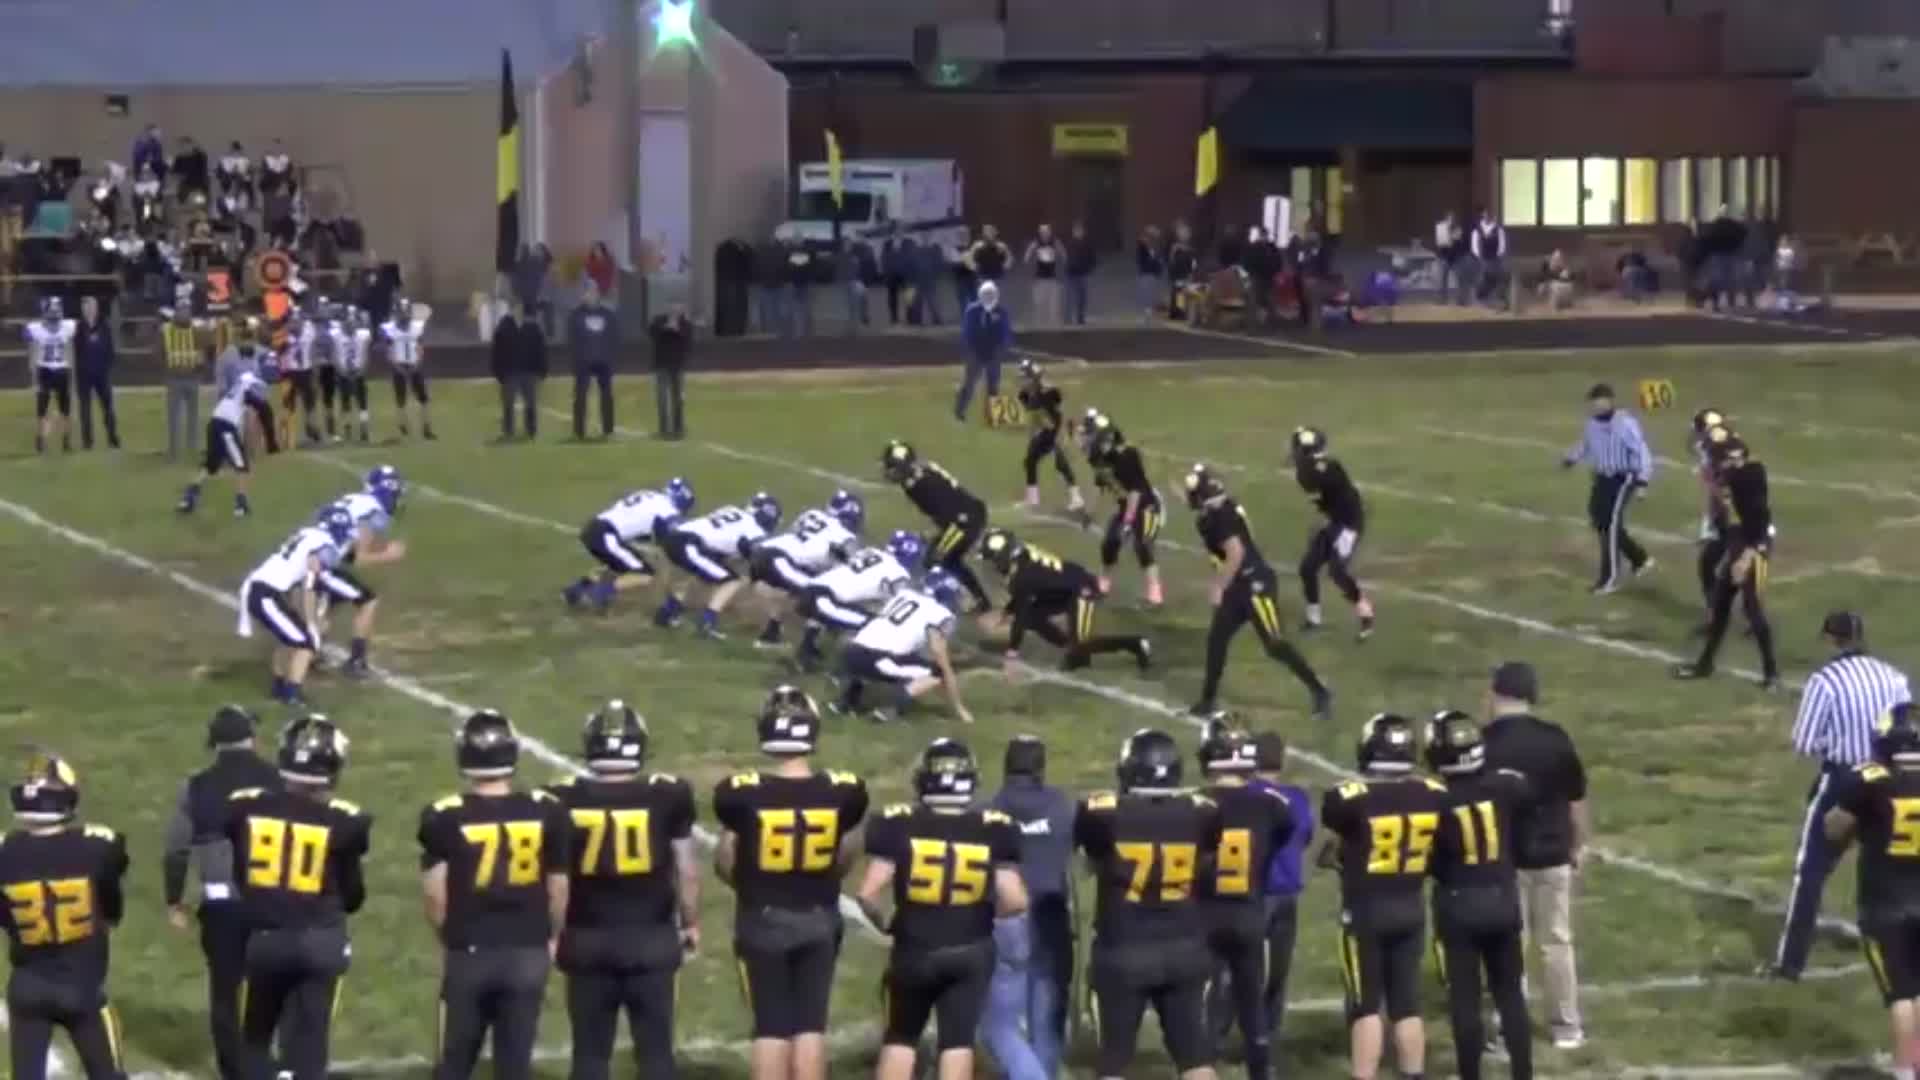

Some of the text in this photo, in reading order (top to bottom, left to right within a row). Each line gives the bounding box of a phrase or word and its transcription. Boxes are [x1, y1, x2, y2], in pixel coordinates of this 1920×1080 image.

[247, 815, 330, 894] 90
[461, 820, 543, 889] 78
[570, 808, 651, 876] 70
[757, 807, 838, 873] 62
[1366, 811, 1440, 874] 85
[1453, 800, 1499, 866] 11
[906, 837, 990, 905] 55
[1114, 841, 1198, 903] 79
[3, 876, 93, 946] 32
